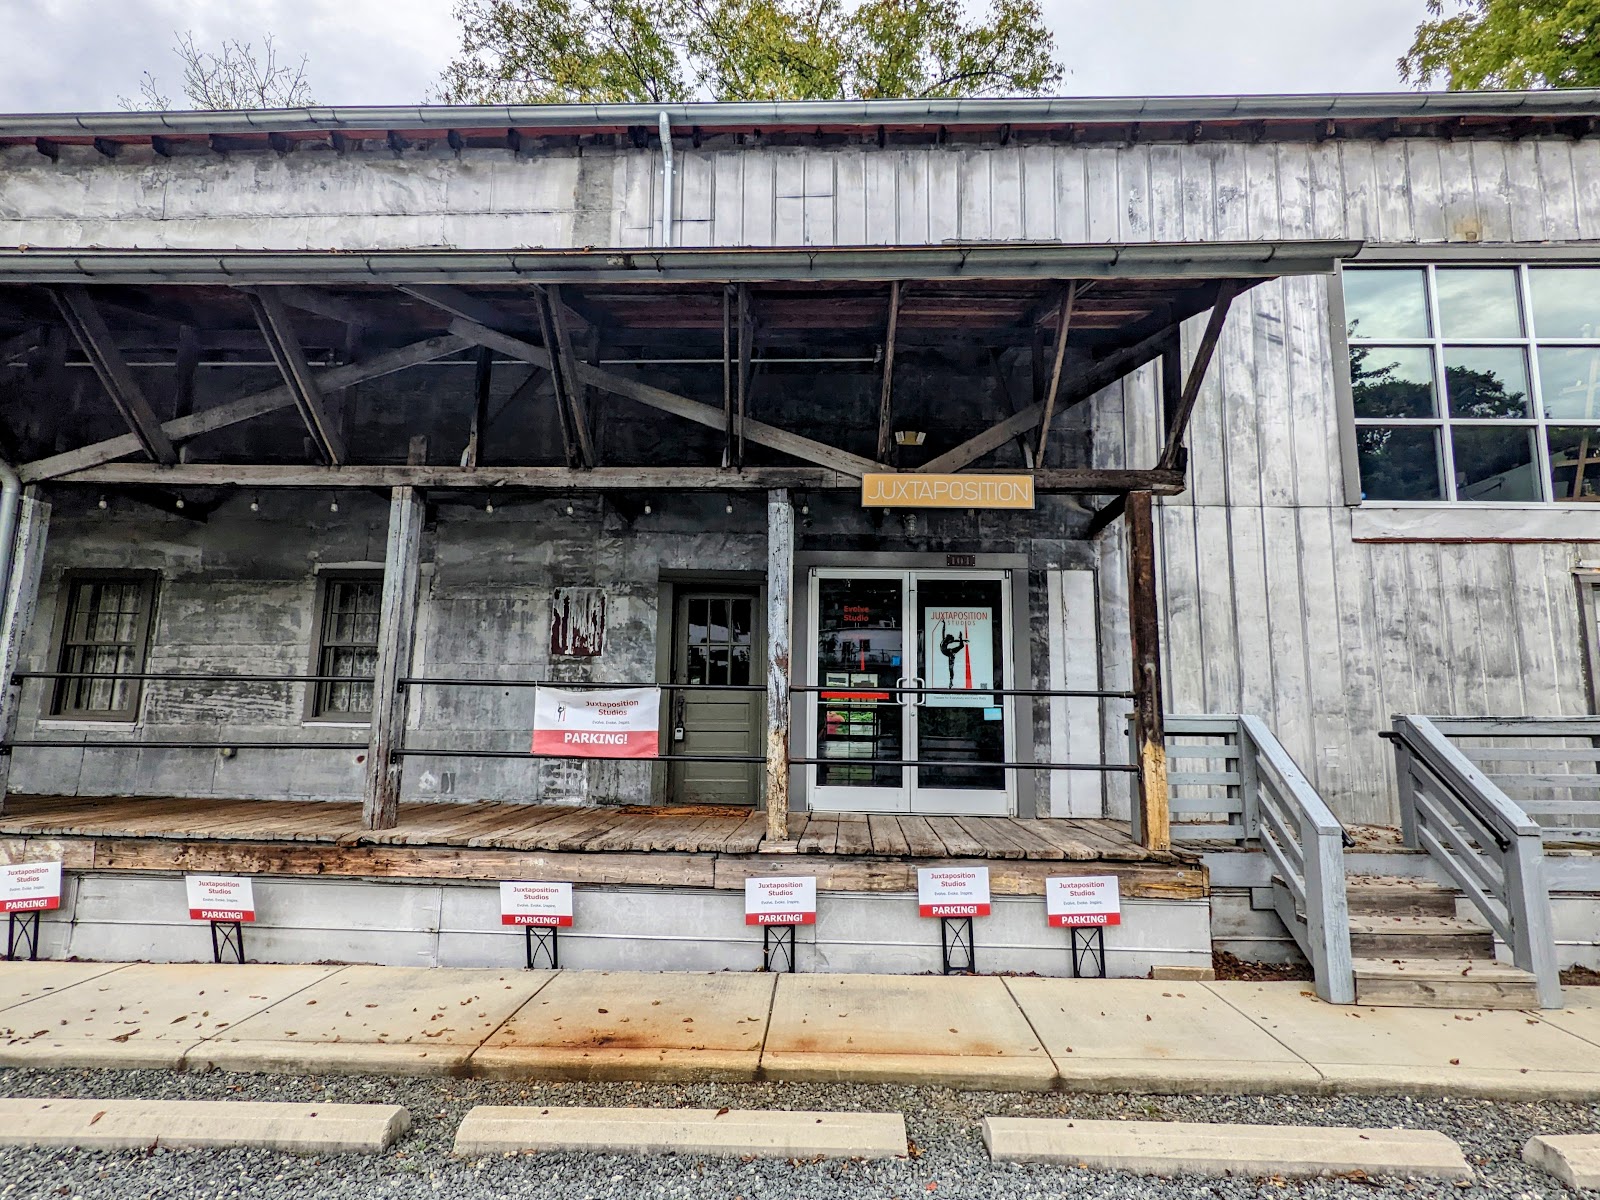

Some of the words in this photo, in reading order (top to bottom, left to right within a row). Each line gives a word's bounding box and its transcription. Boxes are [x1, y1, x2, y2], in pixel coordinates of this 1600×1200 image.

[868, 480, 1028, 501] JUXTAPOSITION
[930, 612, 988, 620] JUXTAPOSITION
[586, 700, 639, 708] Juxtaposition
[564, 732, 628, 744] PARKING!
[8, 868, 49, 876] Juxtaposition
[6, 899, 48, 910] PARKING!
[932, 906, 977, 914] PARKING!
[202, 911, 243, 919] PARKING!
[758, 914, 803, 922] PARKING!
[514, 916, 560, 924] PARKING!
[1061, 915, 1107, 924] PARKING!
